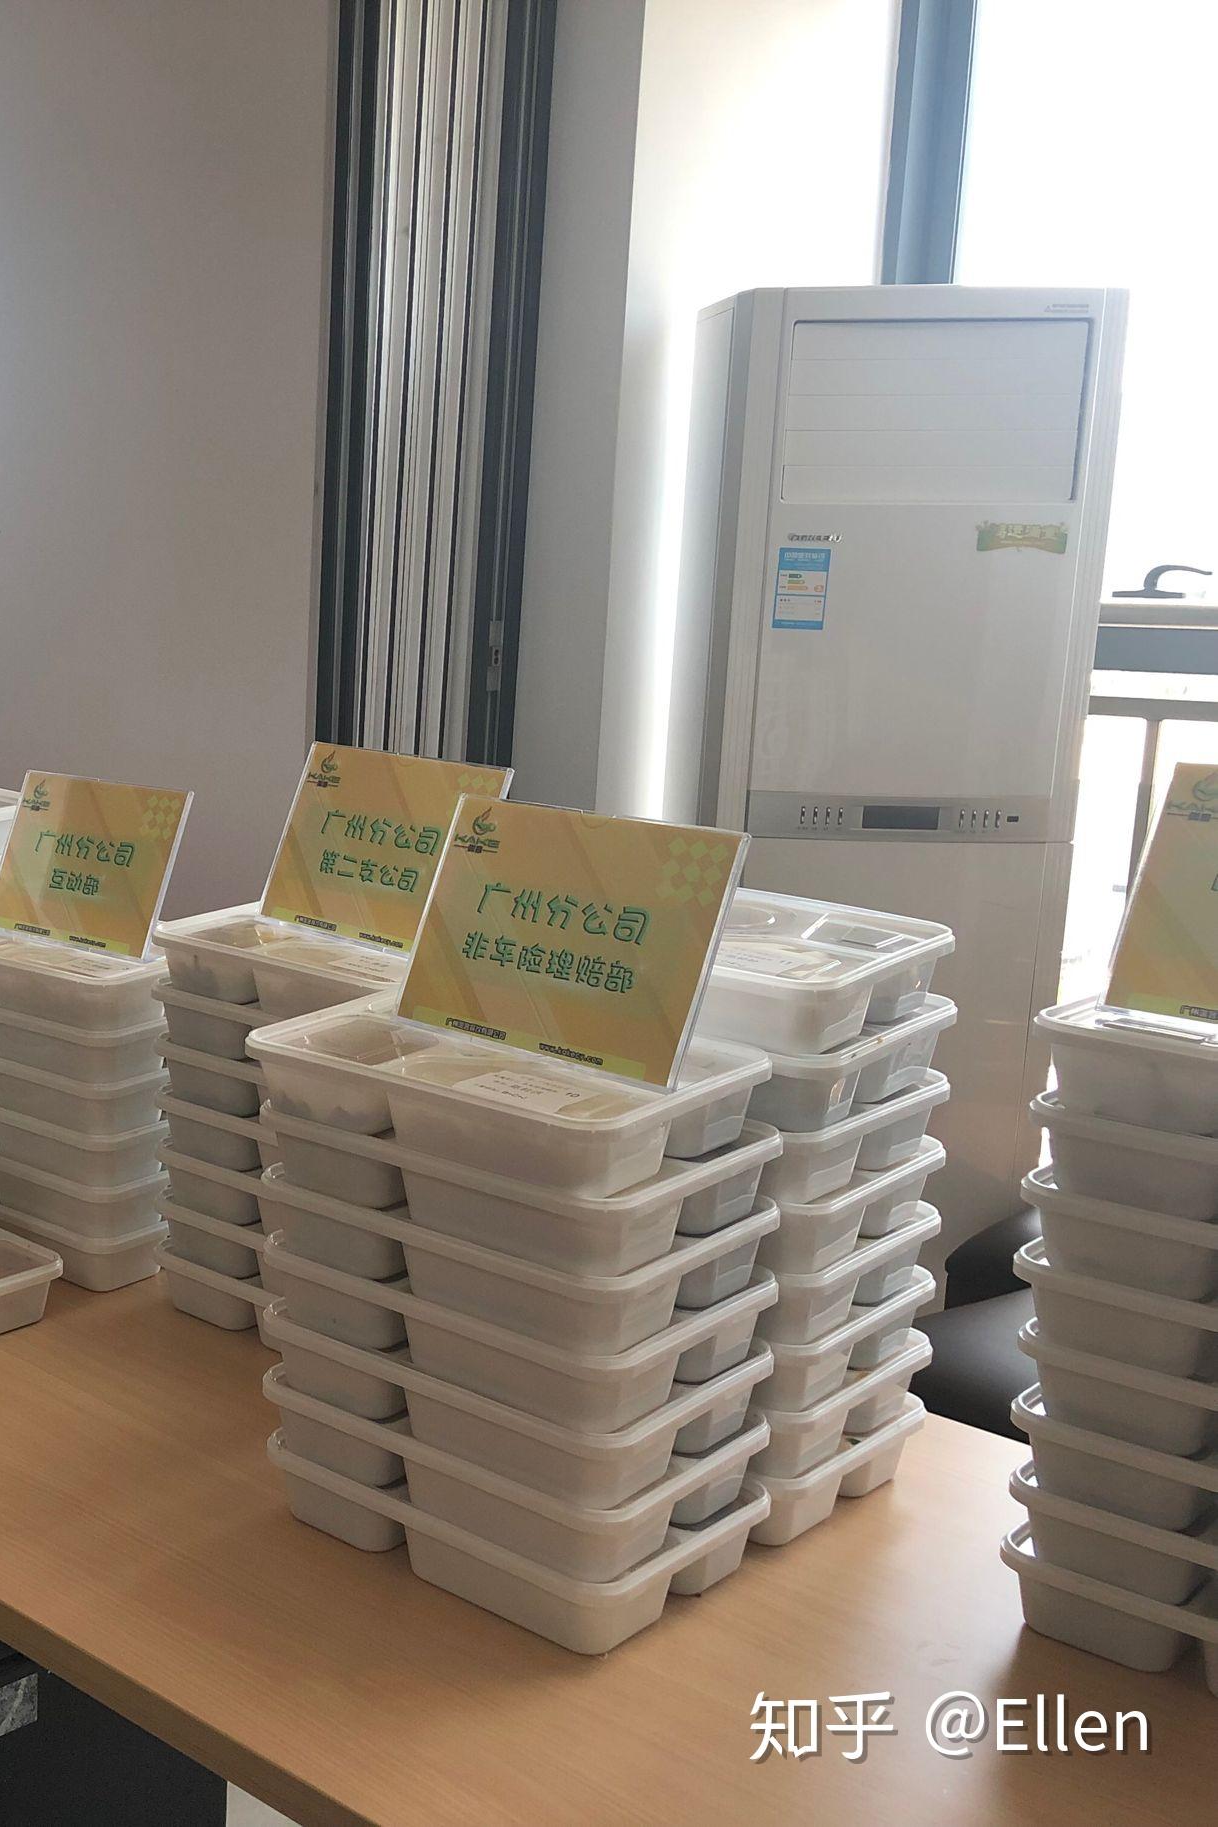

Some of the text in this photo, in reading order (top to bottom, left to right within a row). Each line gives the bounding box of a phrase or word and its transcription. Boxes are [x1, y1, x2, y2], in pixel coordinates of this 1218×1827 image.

[35, 830, 135, 868] 广州分公司
[321, 810, 442, 857] 广州分公司
[453, 834, 500, 848] KAKE
[49, 868, 100, 896] 互动部
[319, 849, 419, 893] 第二支公司
[476, 882, 651, 946] 广州分公司
[462, 930, 633, 994] 非车险理赔部
[539, 1043, 603, 1065] www.kakecy.com
